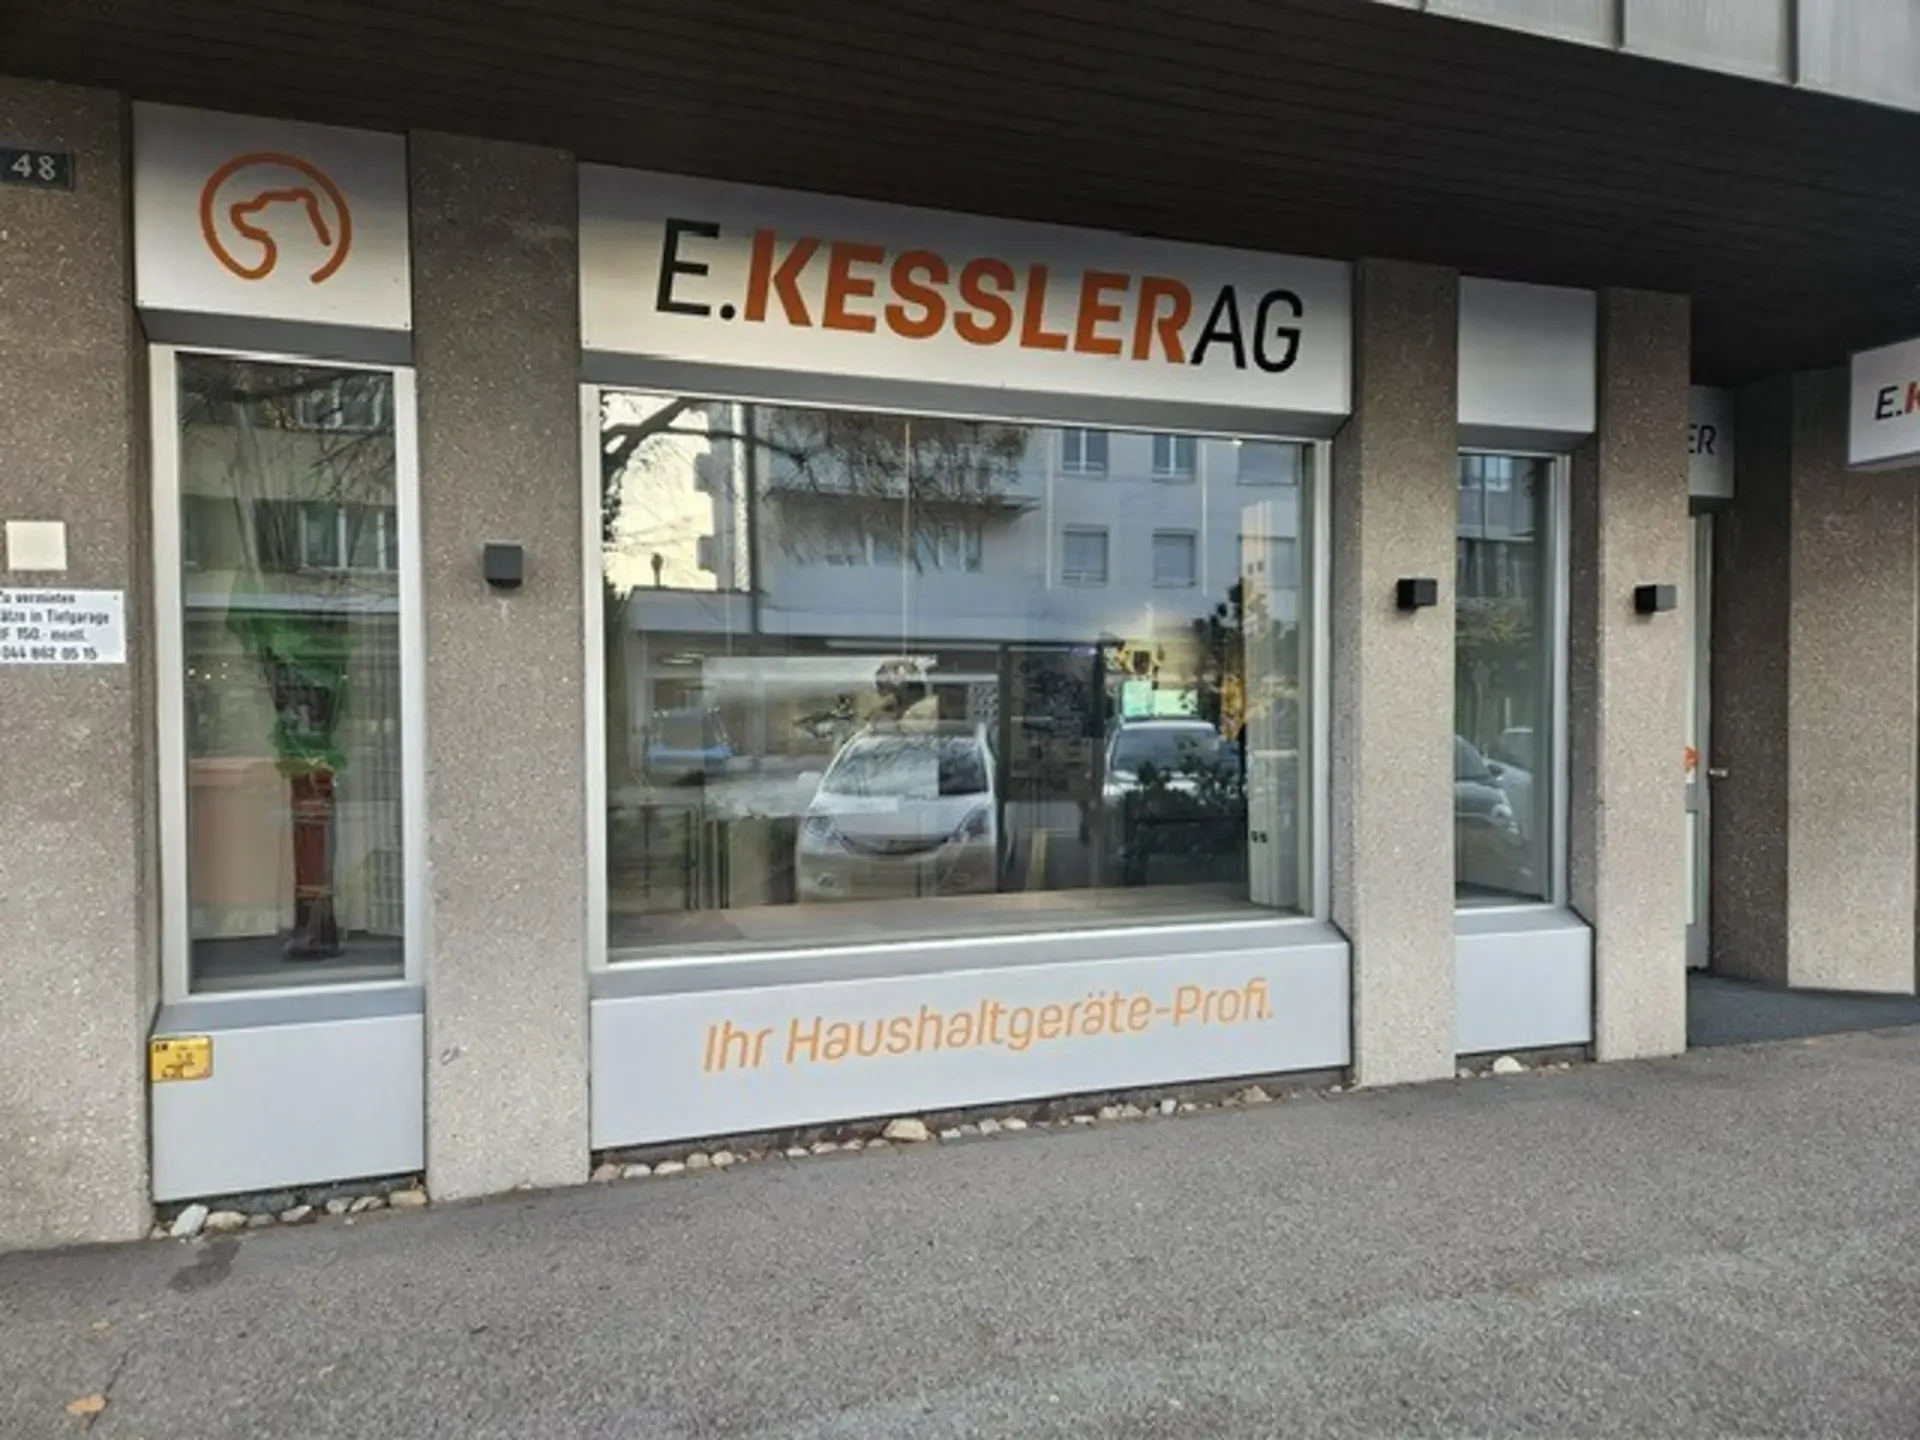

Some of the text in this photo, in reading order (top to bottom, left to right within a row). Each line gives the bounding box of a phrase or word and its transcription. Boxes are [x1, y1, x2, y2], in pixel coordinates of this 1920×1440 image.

[11, 152, 56, 180] 48
[15, 593, 76, 604] vermieten
[30, 609, 43, 623] in
[47, 608, 109, 626] Tiefgarage
[702, 977, 1275, 1074] Ihr Haushaltgeräte-Profi.
